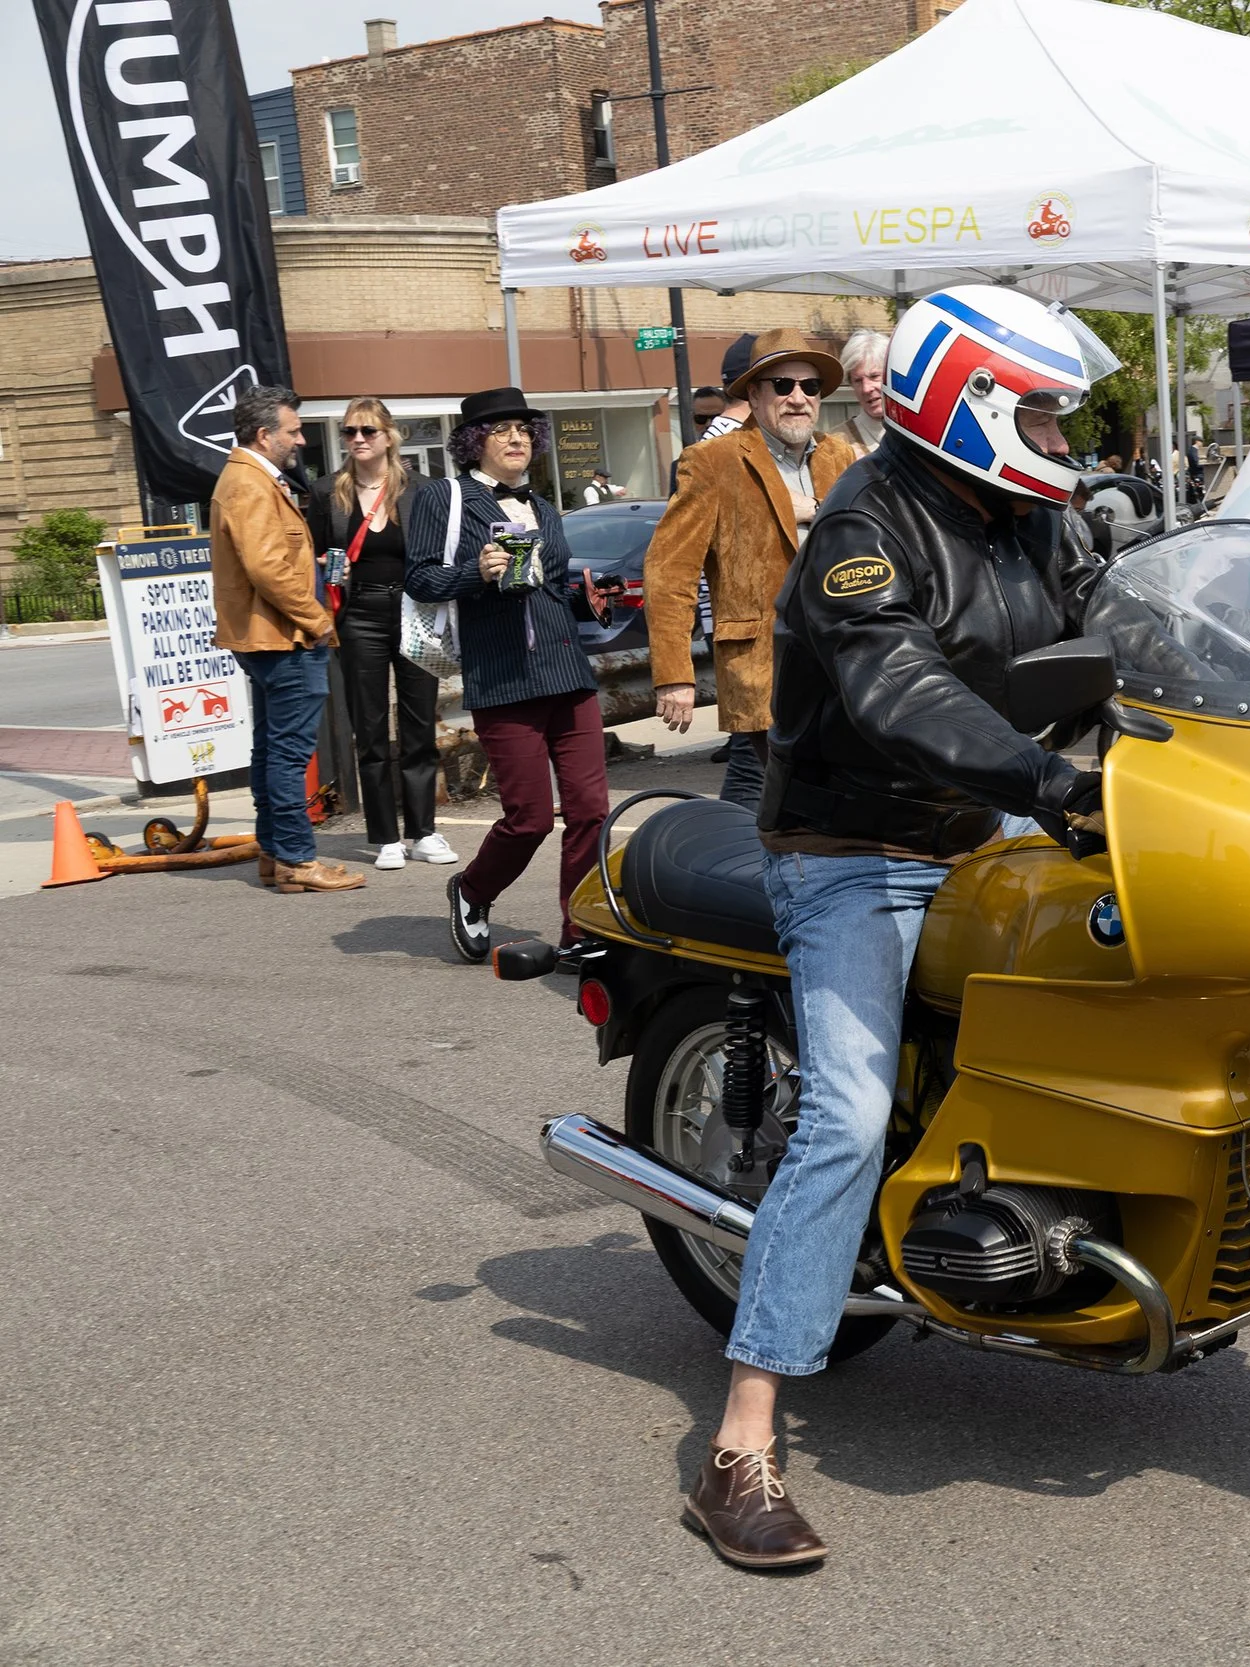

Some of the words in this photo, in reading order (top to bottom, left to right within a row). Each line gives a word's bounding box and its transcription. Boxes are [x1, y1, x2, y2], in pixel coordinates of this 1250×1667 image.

[643, 220, 719, 258] LIVE
[730, 210, 840, 252] MORE
[853, 206, 982, 246] VESPA
[643, 329, 668, 338] HALSTED
[118, 552, 158, 569] RAMOVA
[832, 565, 884, 584] vanson
[147, 582, 175, 606] SPOT
[178, 579, 209, 603] HERO
[142, 608, 191, 634] PARKING
[194, 606, 217, 628] ONL
[154, 636, 175, 659] ALL
[144, 664, 174, 688] WILL
[177, 661, 193, 683] BE
[195, 655, 235, 680] TOWED
